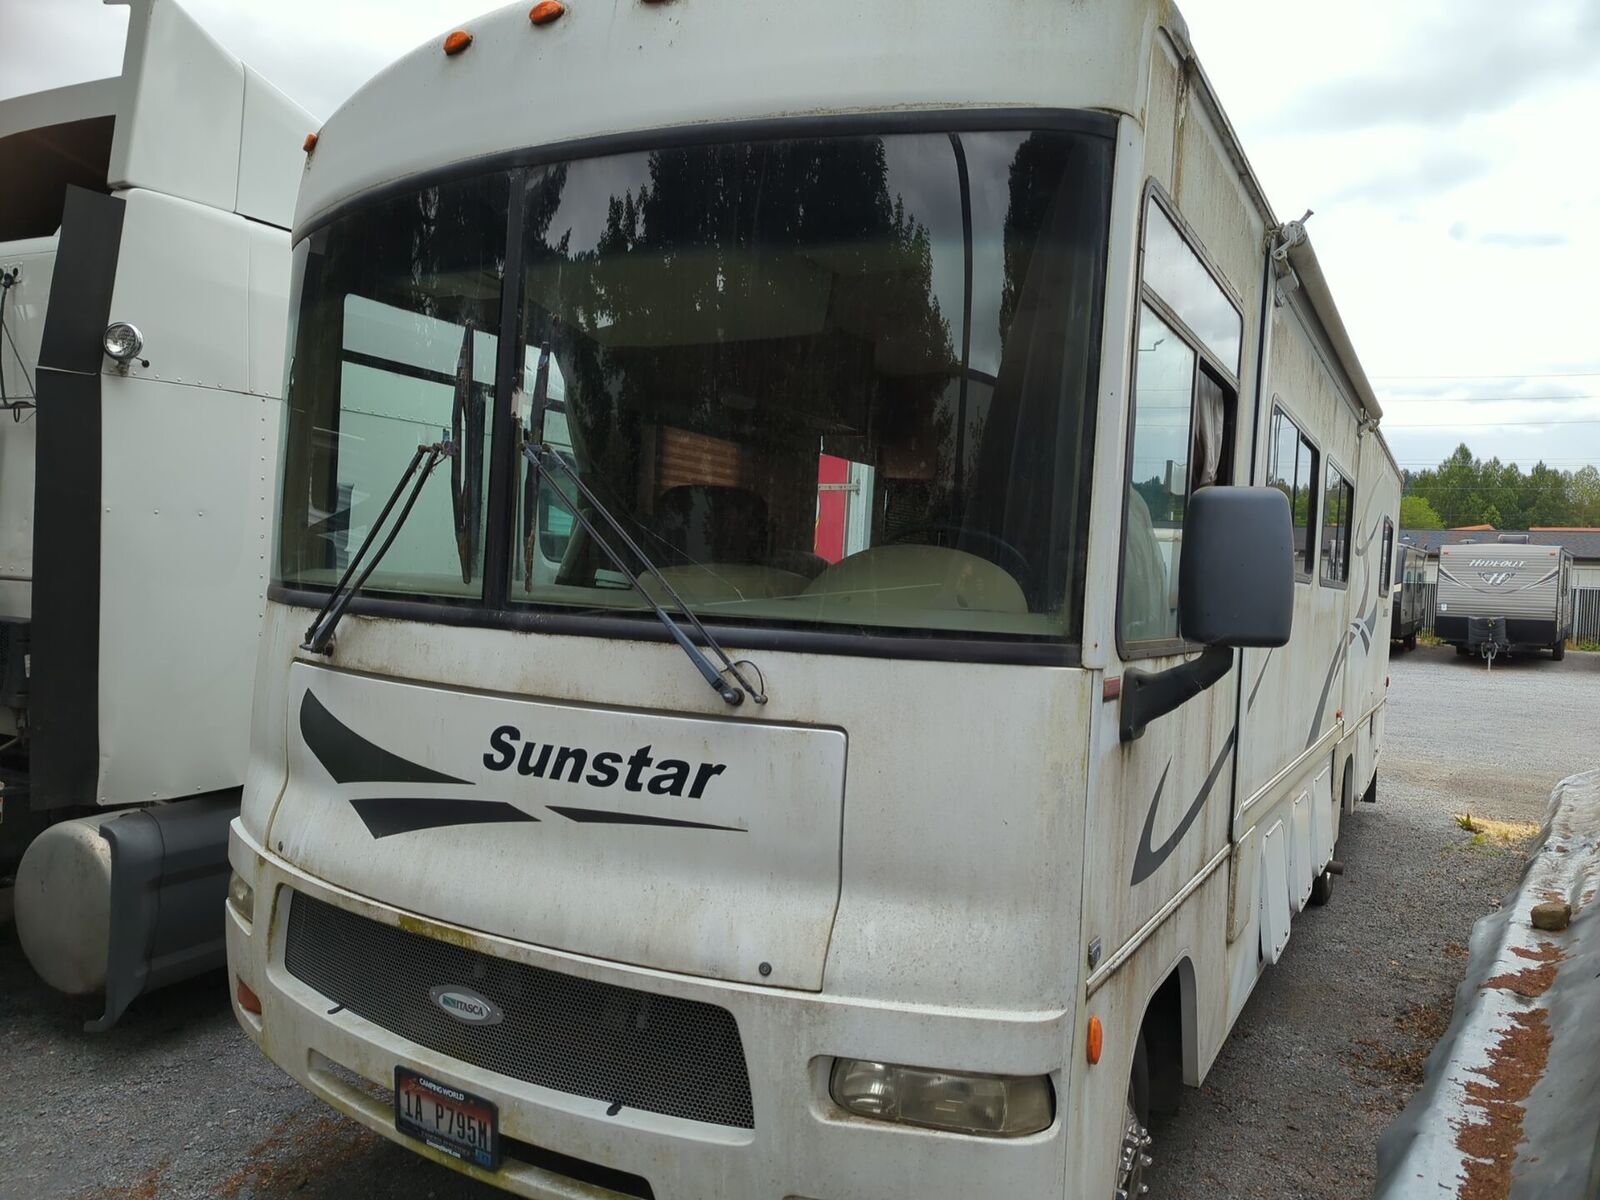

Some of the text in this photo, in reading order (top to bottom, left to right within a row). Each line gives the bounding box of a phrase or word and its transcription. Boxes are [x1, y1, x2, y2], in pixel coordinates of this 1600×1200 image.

[1469, 559, 1526, 568] HIDEOUT
[483, 725, 727, 800] Sunstar
[456, 1000, 484, 1017] ITASCA
[419, 1078, 443, 1094] CAMPING
[442, 1087, 465, 1101] WORLD
[404, 1090, 423, 1123] 1A
[435, 1102, 488, 1152] P795M
